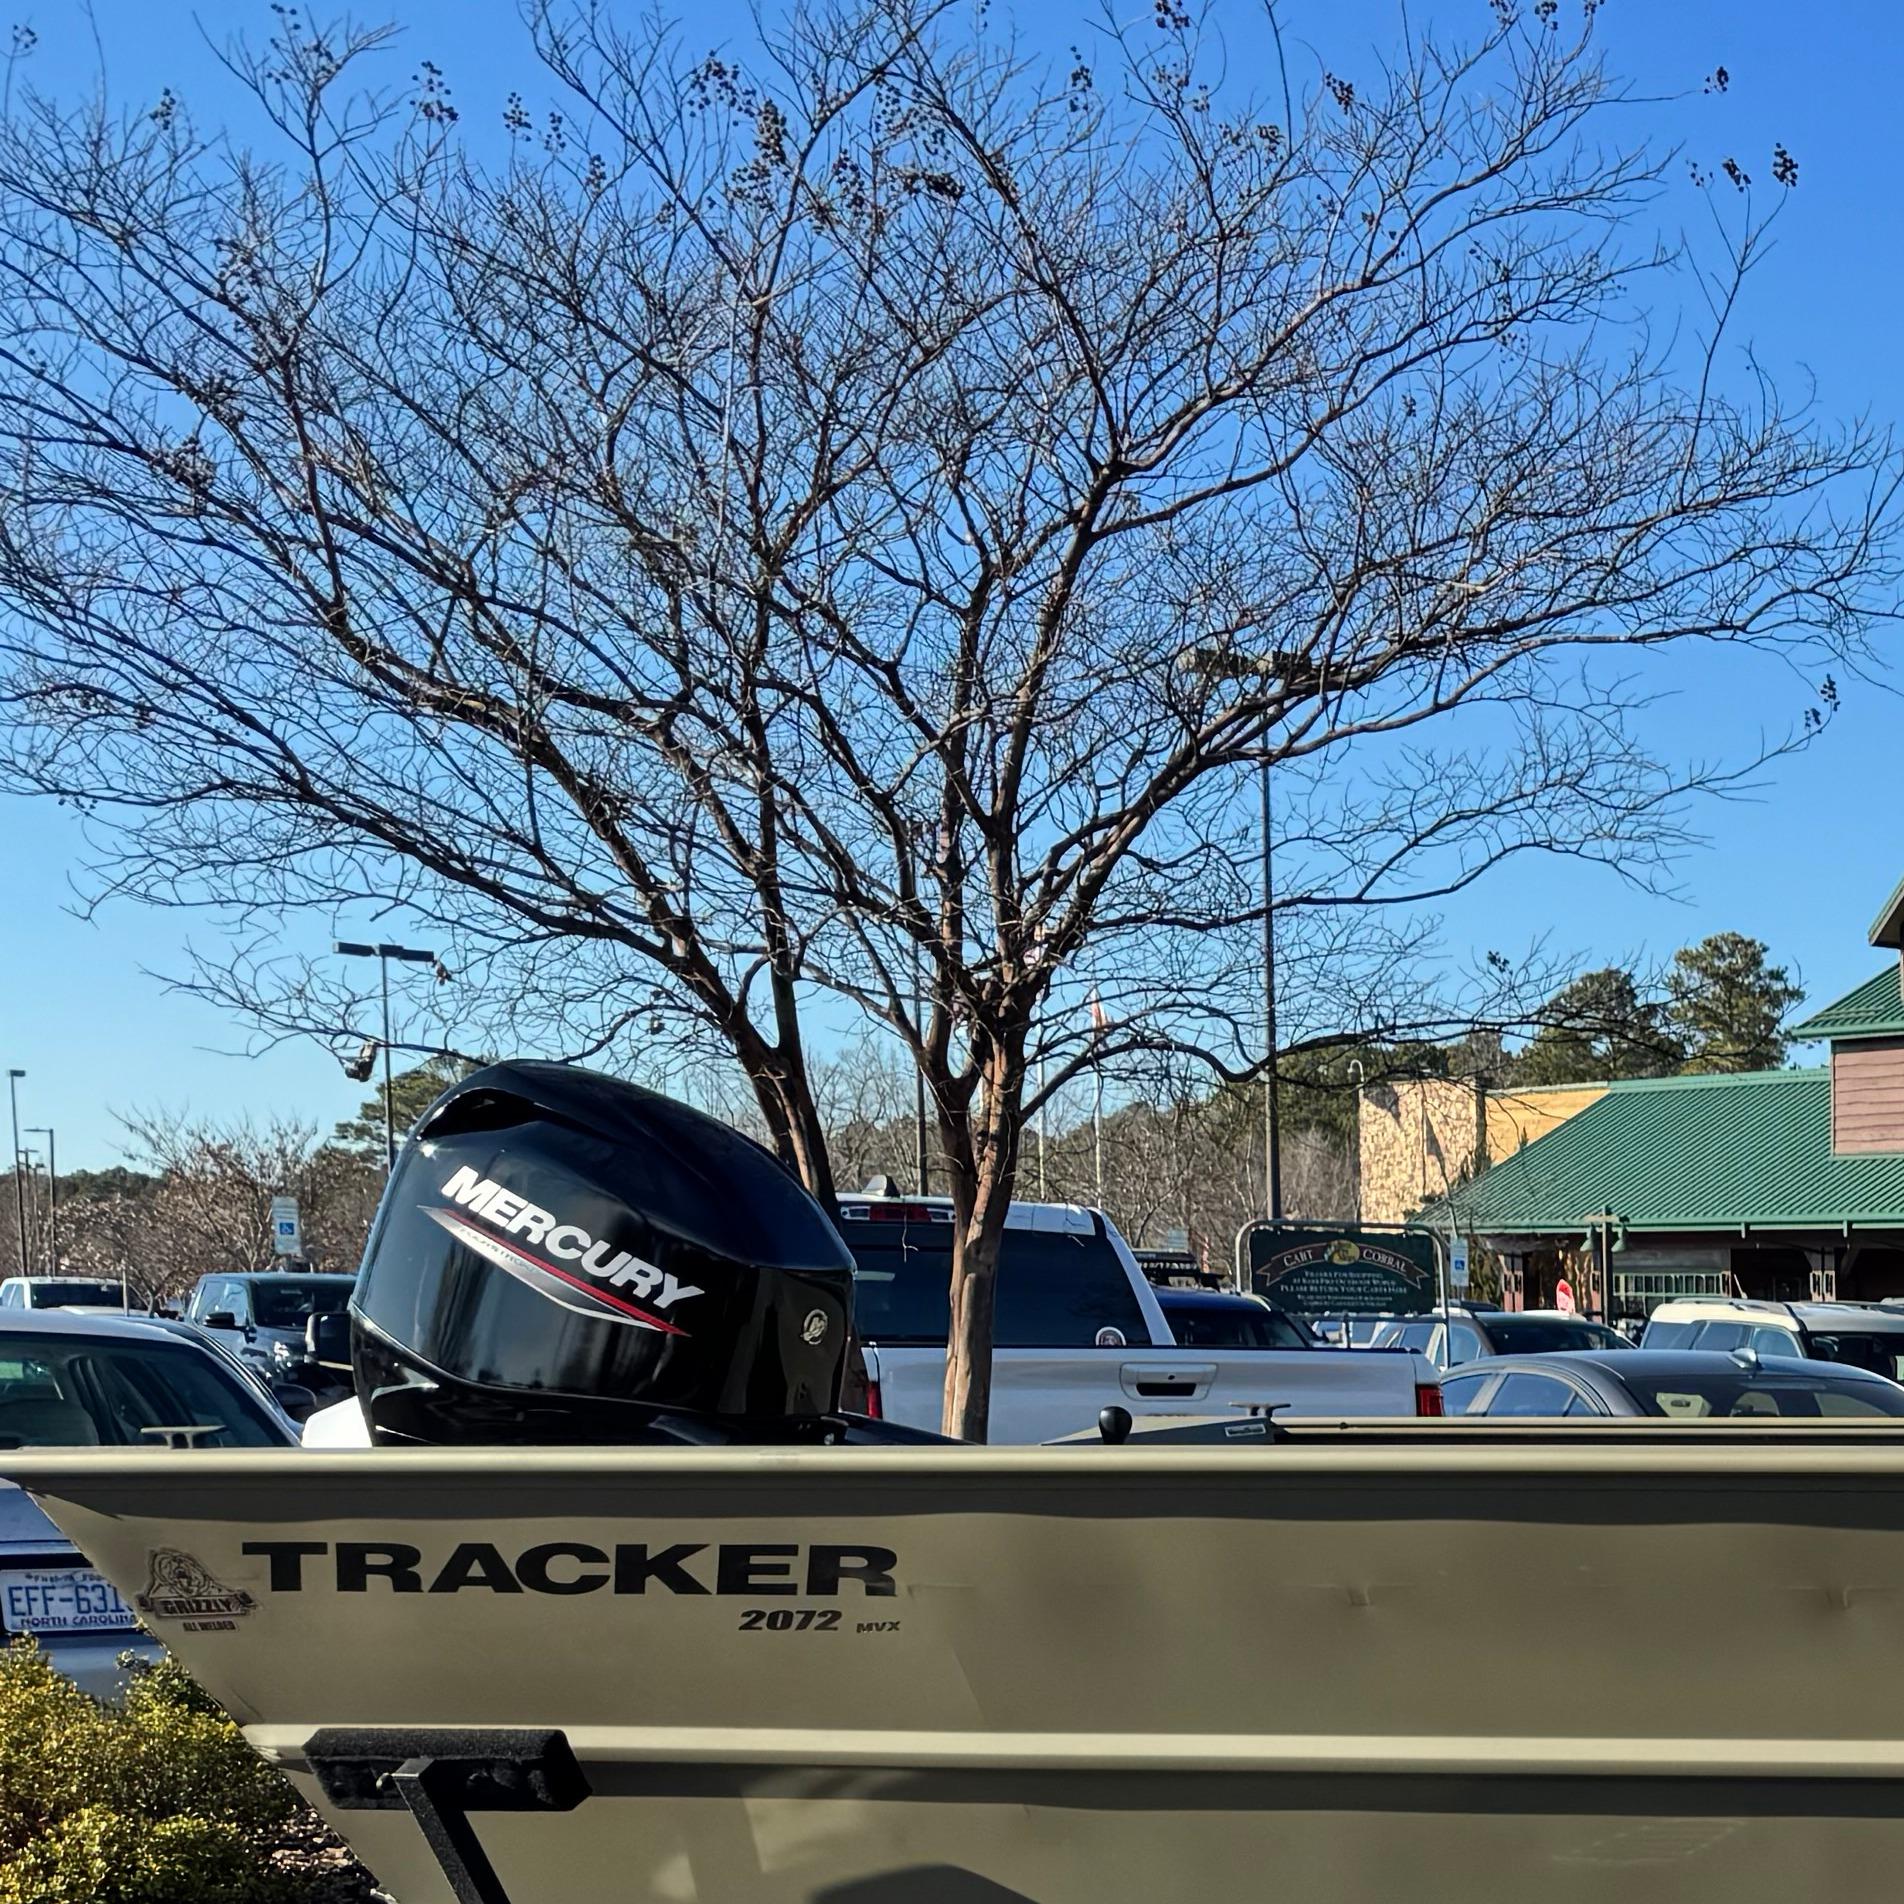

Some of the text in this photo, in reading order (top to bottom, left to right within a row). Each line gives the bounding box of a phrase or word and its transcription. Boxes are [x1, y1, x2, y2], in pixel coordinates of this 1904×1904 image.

[440, 1165, 705, 1309] MERCURY
[1284, 1249, 1407, 1272] CART CORRAL
[242, 1541, 899, 1596] TRACKER
[8, 1583, 133, 1617] EFF-631
[160, 1598, 234, 1615] GRIZZLY
[21, 1616, 68, 1627] NORTH
[738, 1610, 901, 1633] 2072 MVX
